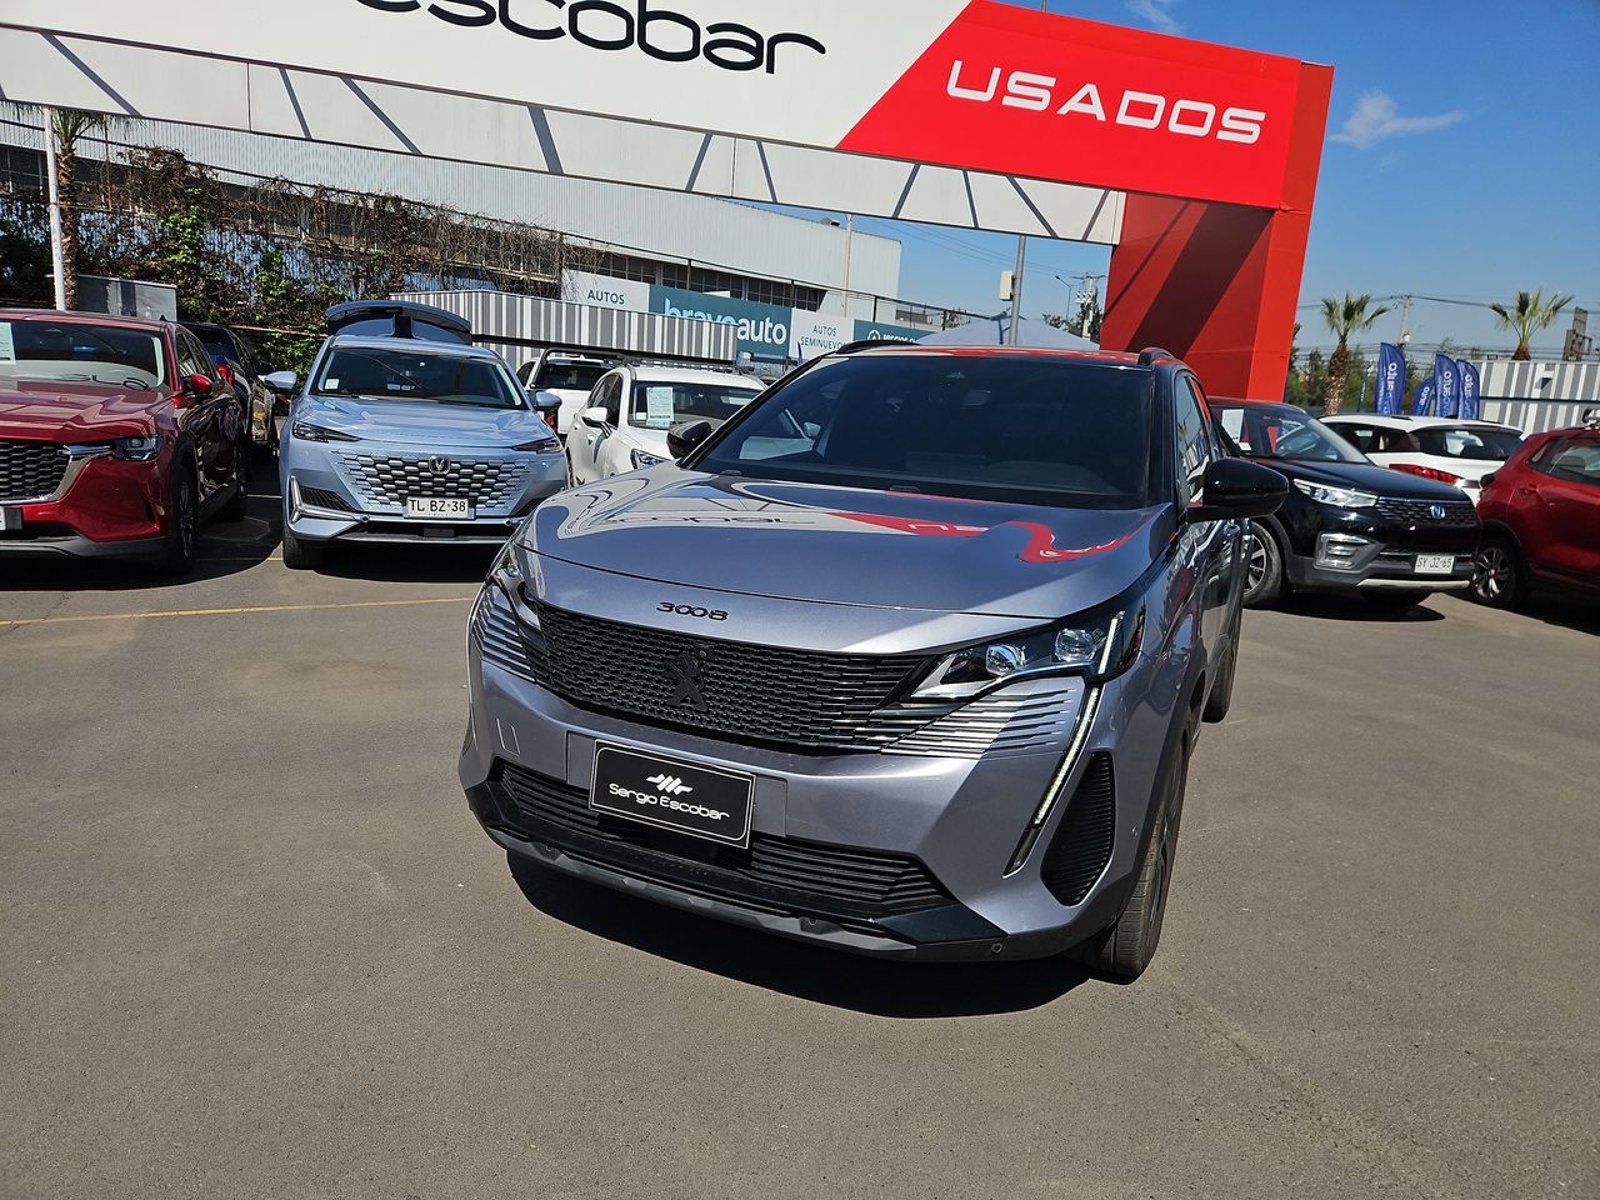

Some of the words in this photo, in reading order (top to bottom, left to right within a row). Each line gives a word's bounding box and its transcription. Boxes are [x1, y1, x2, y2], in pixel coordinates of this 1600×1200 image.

[355, 0, 826, 74] scobar
[946, 59, 1267, 145] USADOS
[587, 289, 626, 305] AUTOS
[812, 325, 837, 337] AUTOS
[409, 500, 425, 511] TL
[656, 602, 728, 621] 3008
[659, 795, 730, 821] Escobar
